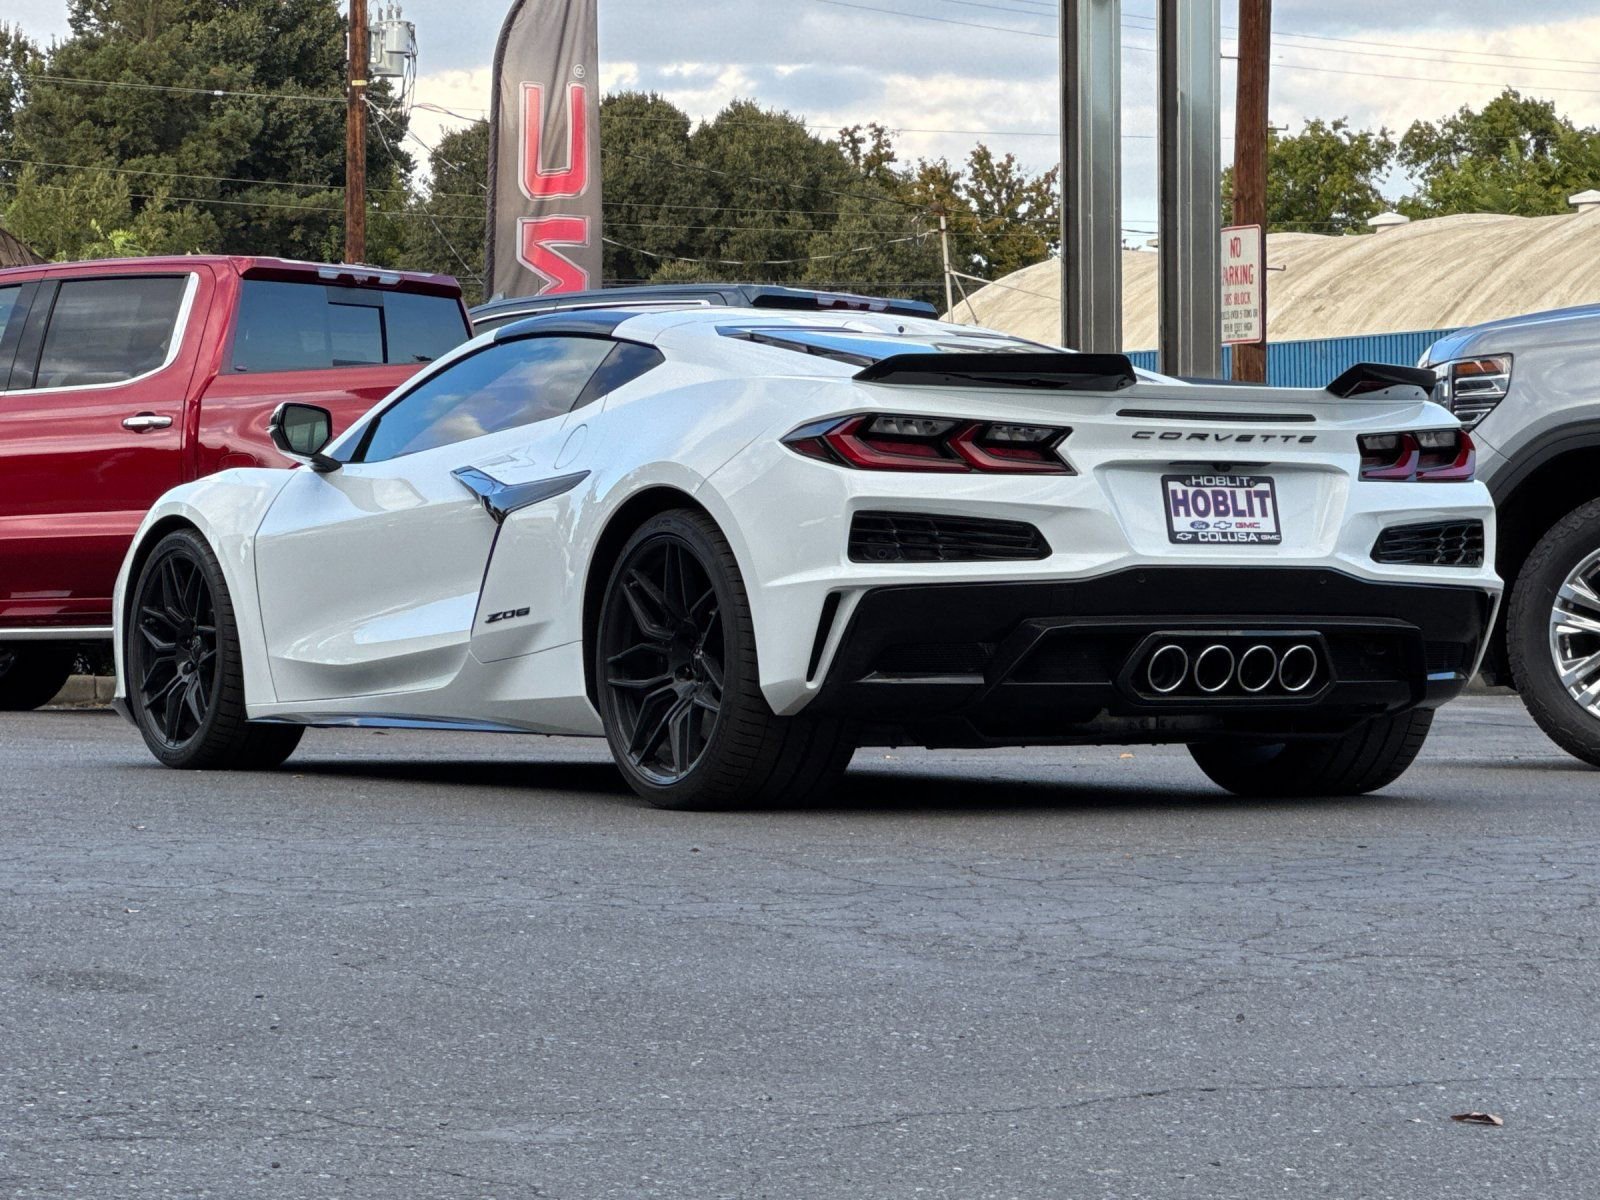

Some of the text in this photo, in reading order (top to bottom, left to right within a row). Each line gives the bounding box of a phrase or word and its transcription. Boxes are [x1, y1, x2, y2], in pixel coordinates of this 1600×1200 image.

[516, 81, 590, 297] MC
[1230, 237, 1241, 258] NO
[1233, 292, 1251, 305] BLOCK
[1132, 431, 1317, 443] CORVETTE
[1191, 476, 1250, 486] HOBLIT
[1170, 489, 1271, 518] HOBLIT
[1198, 532, 1259, 542] COLUSA
[484, 607, 531, 624] Z06
